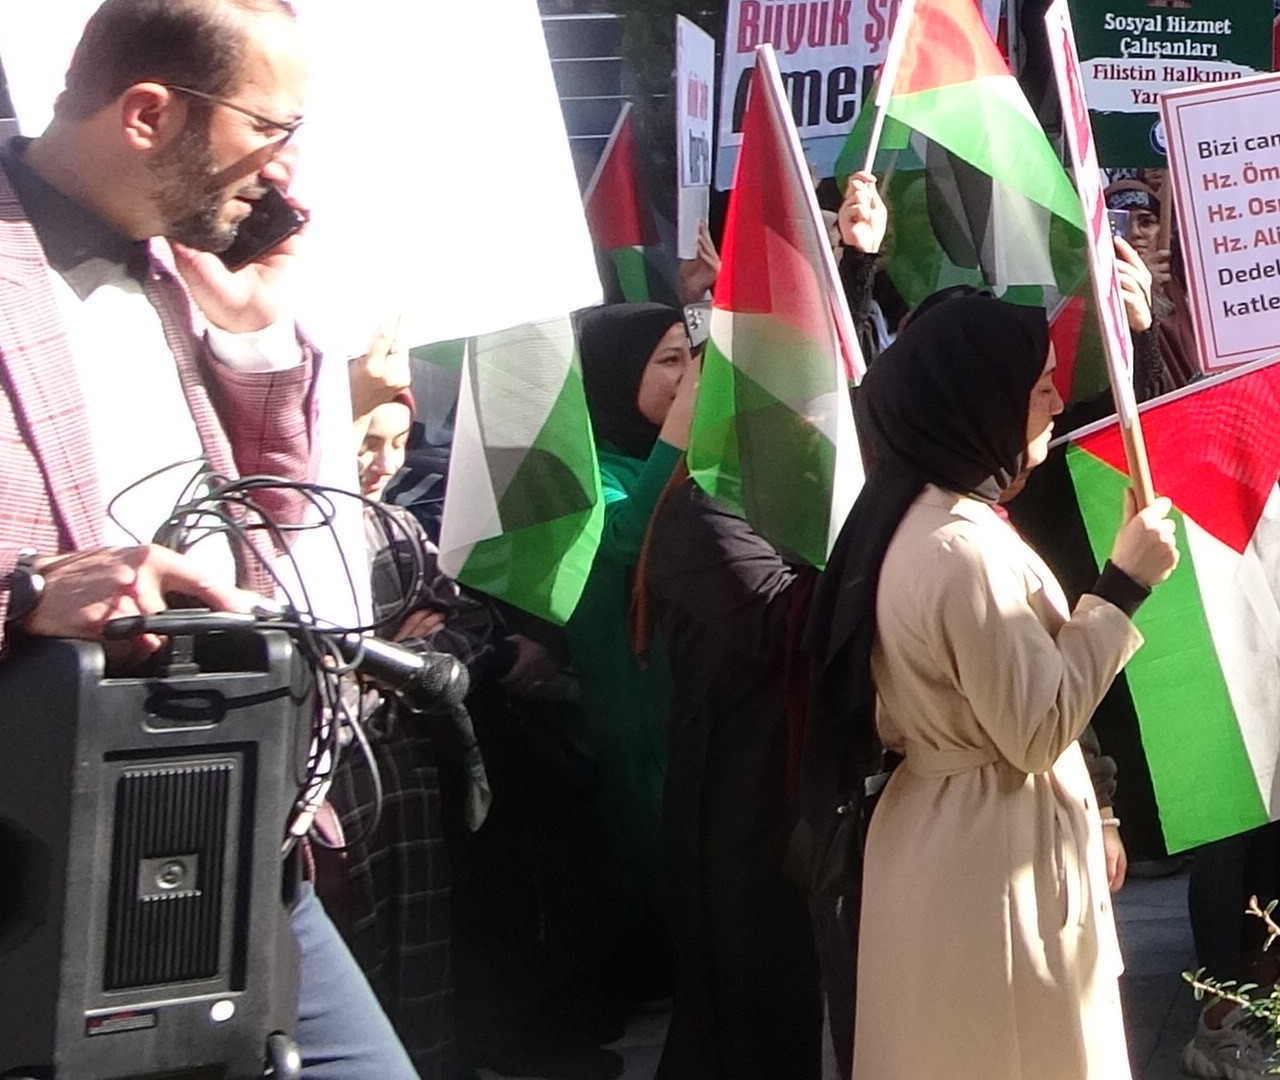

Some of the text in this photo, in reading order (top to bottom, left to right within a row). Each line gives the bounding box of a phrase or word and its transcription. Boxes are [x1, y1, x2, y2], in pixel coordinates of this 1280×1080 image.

[1104, 12, 1232, 36] Sosyal Hizmet
[1120, 37, 1218, 59] Çalışanları
[1093, 63, 1156, 82] Filistin
[1198, 136, 1238, 160] Bizi
[1202, 169, 1238, 192] Hz.
[1207, 202, 1243, 224] Hz.
[1213, 232, 1248, 255] Hz.
